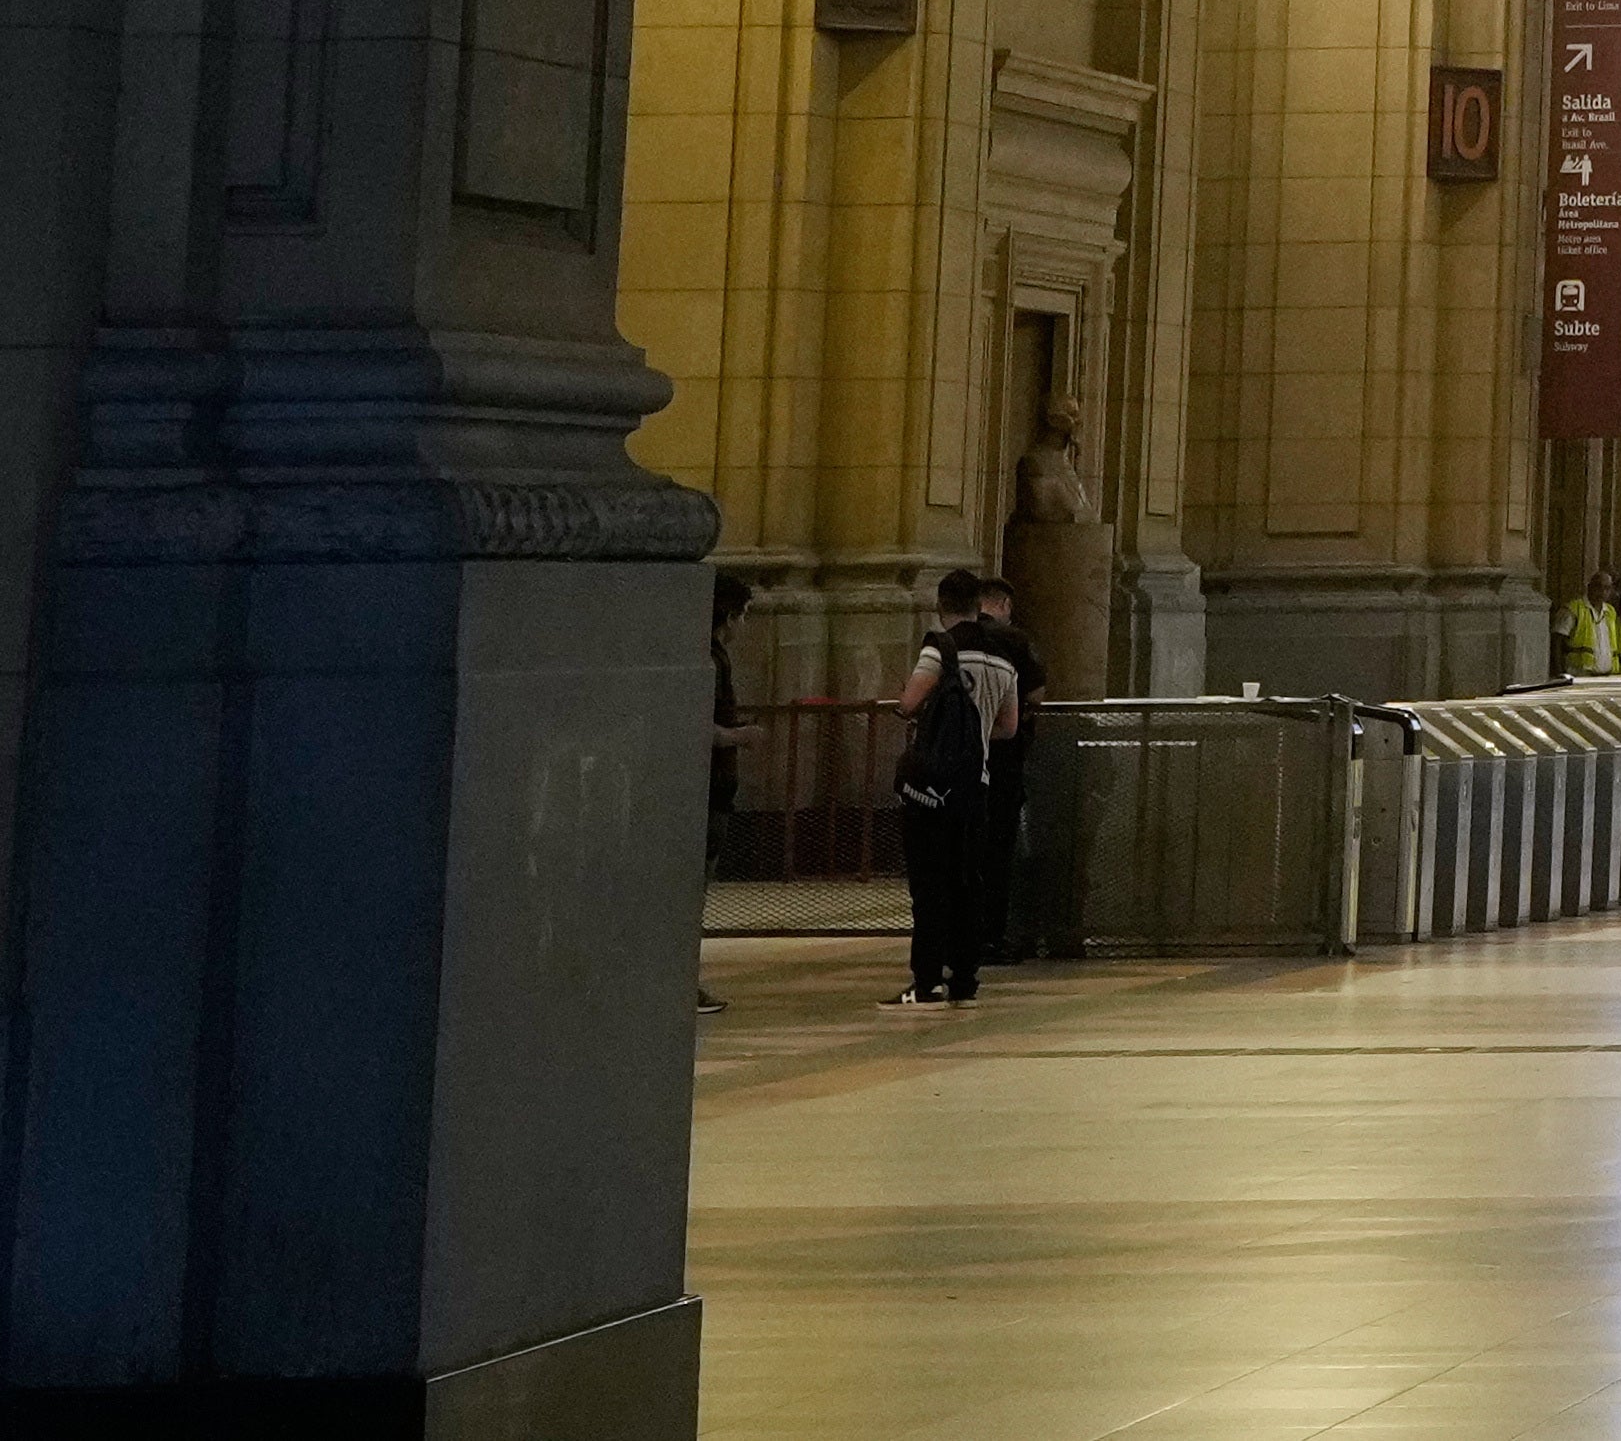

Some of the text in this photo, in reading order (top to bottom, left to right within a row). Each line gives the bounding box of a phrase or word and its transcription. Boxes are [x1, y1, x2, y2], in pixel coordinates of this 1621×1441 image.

[1586, 1, 1595, 11] to
[1562, 94, 1612, 110] Salida
[1440, 85, 1487, 160] 10
[1562, 114, 1568, 122] a
[1588, 112, 1616, 122] Brasil
[1554, 320, 1601, 336] Subte
